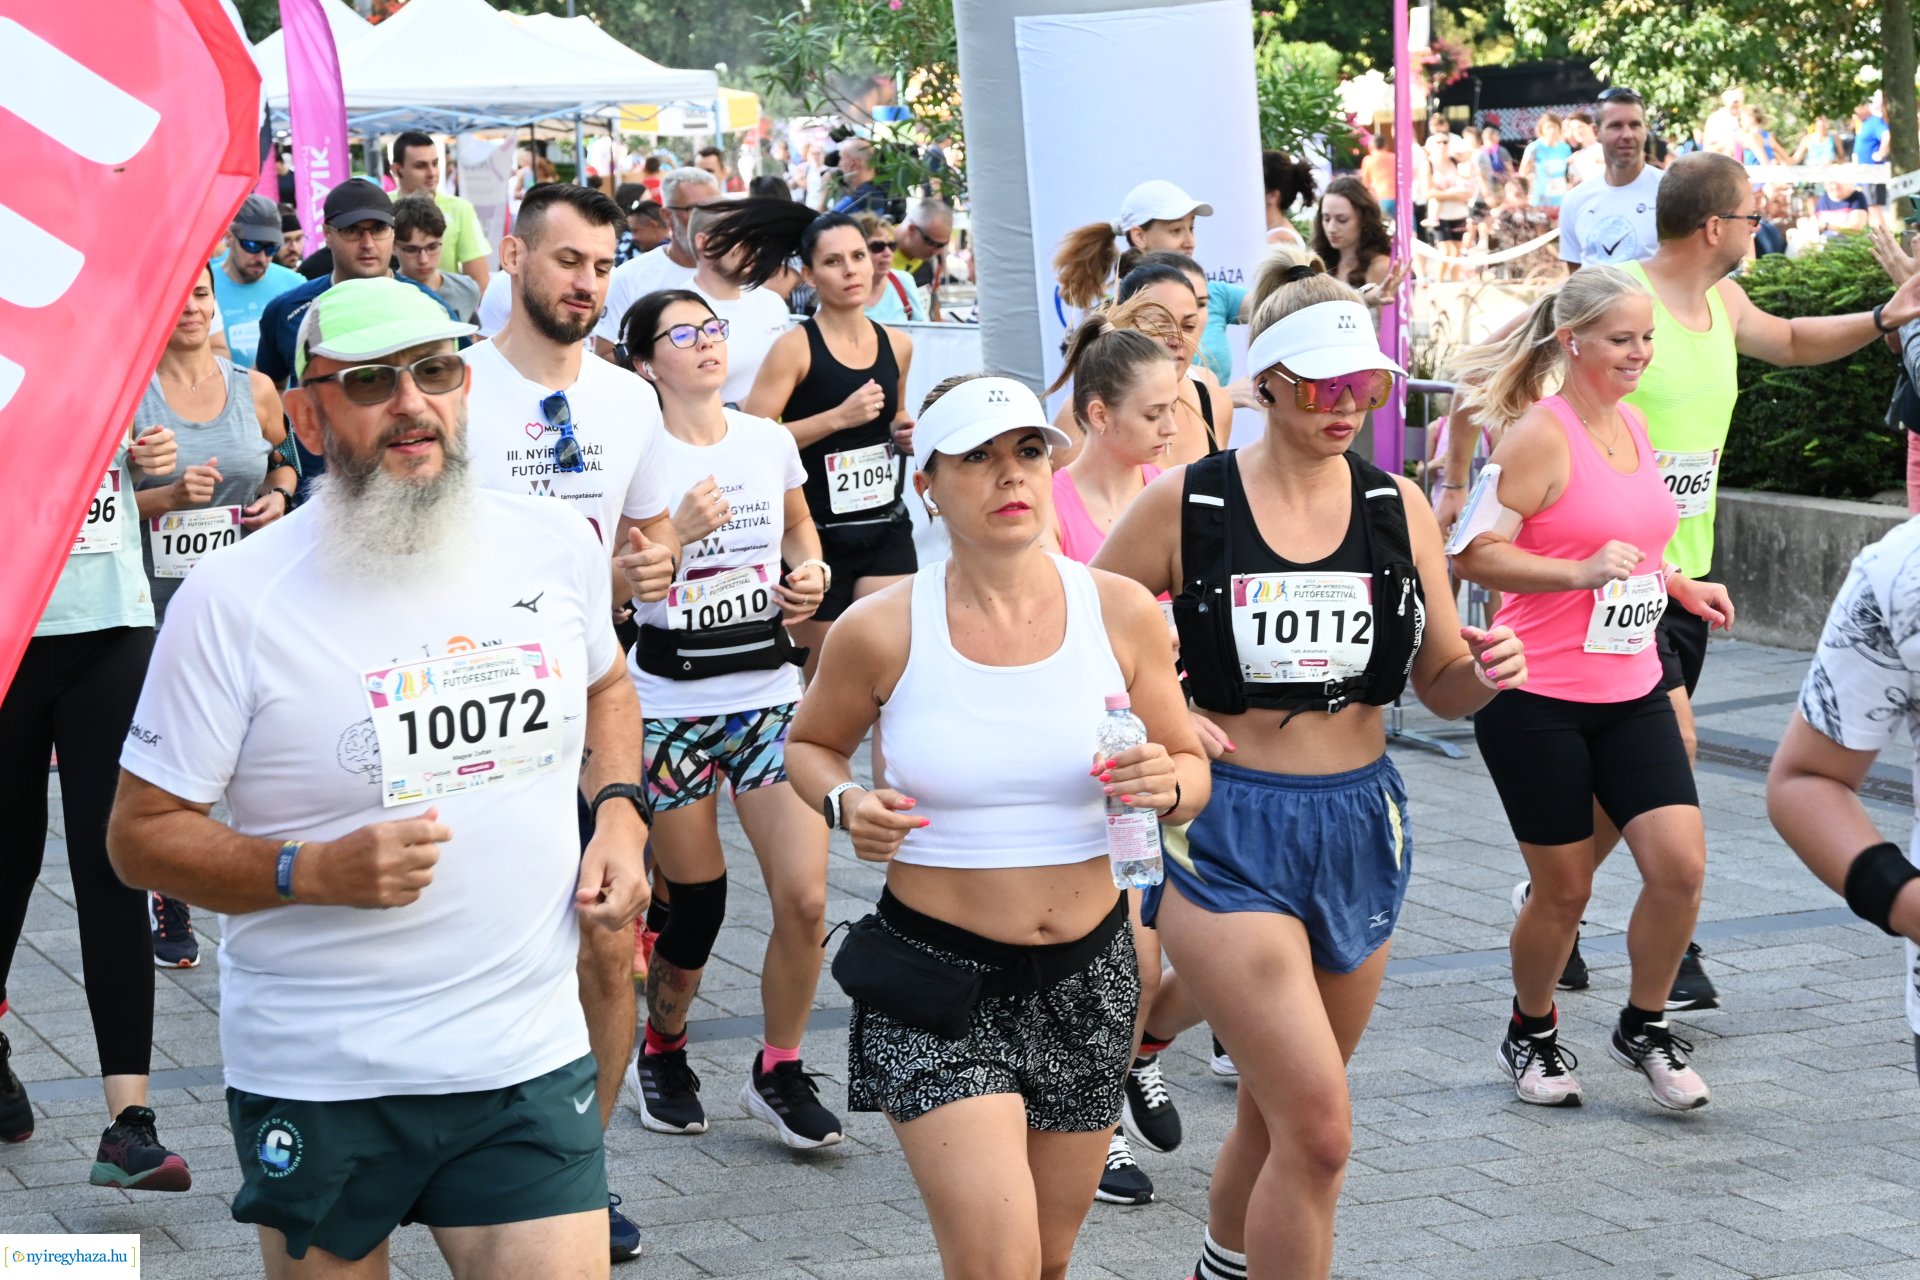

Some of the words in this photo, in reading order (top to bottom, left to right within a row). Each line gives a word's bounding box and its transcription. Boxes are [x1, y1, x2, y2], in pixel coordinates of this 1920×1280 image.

[544, 422, 579, 432] MOK
[507, 450, 522, 461] III.
[526, 442, 603, 460] NYÍRHÁZI
[511, 458, 604, 477] FUTÓFEVÁL
[837, 463, 893, 492] 21094
[560, 491, 604, 500] támogatásával
[87, 496, 116, 524] 96
[714, 514, 772, 533] ESZTIVÁL
[162, 528, 236, 555] 10070
[1293, 589, 1358, 600] FUTÓFESZTIVÁL
[681, 588, 768, 632] 10010
[1603, 598, 1663, 628] 10066
[1252, 609, 1372, 646] 10112
[443, 666, 521, 689] FUTÓFESZTIVÁL
[398, 688, 549, 756] 10072
